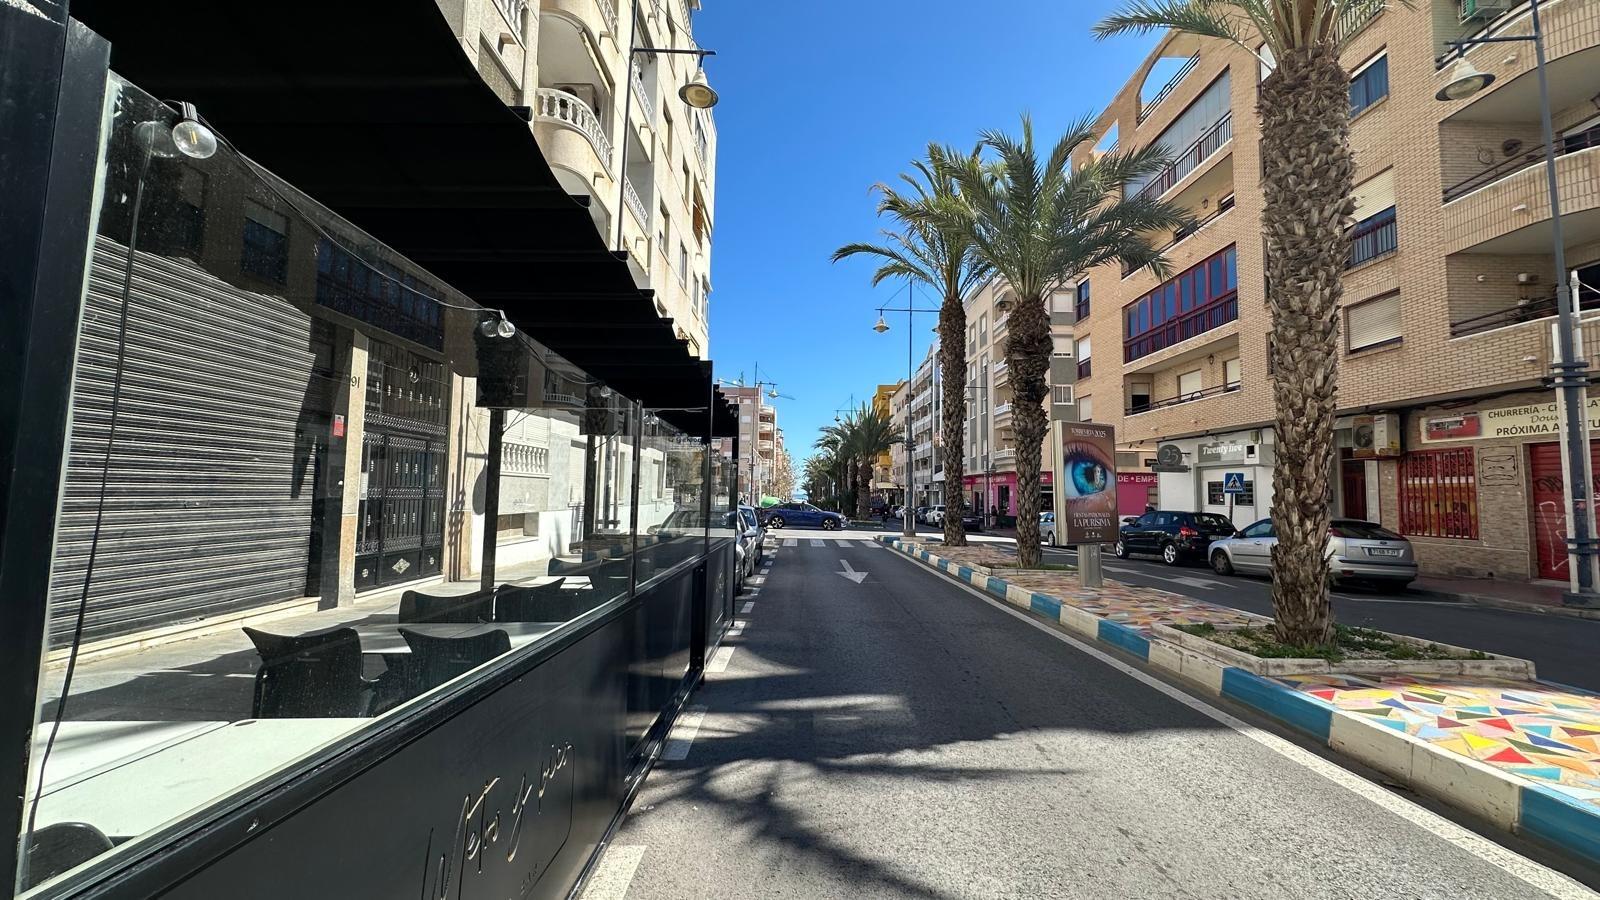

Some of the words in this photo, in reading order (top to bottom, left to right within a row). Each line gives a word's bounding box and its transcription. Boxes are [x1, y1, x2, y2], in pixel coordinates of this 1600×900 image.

[350, 376, 361, 388] 91
[1488, 406, 1540, 419] CHURRERÍA
[1496, 424, 1549, 436] PRÓXIMA
